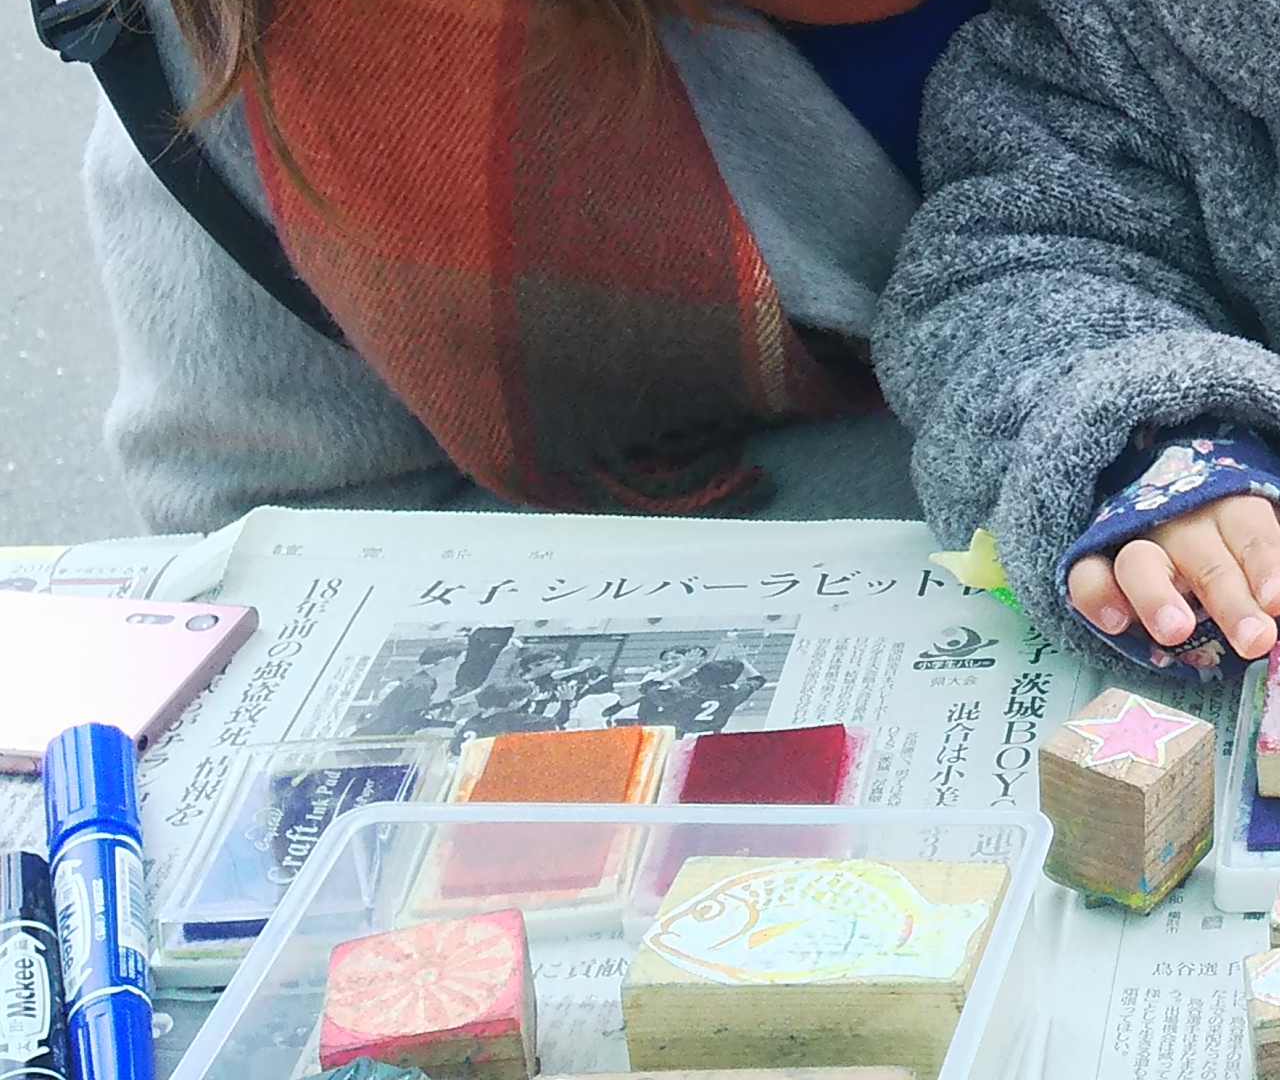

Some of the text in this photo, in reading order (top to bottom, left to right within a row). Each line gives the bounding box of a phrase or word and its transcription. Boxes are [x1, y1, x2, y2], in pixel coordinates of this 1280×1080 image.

[414, 567, 992, 607] 女子 シルバーラビット
[929, 675, 979, 687] 県大会
[316, 769, 342, 796] Pad
[305, 796, 330, 822] Ink
[5, 956, 38, 1019] Mckee
